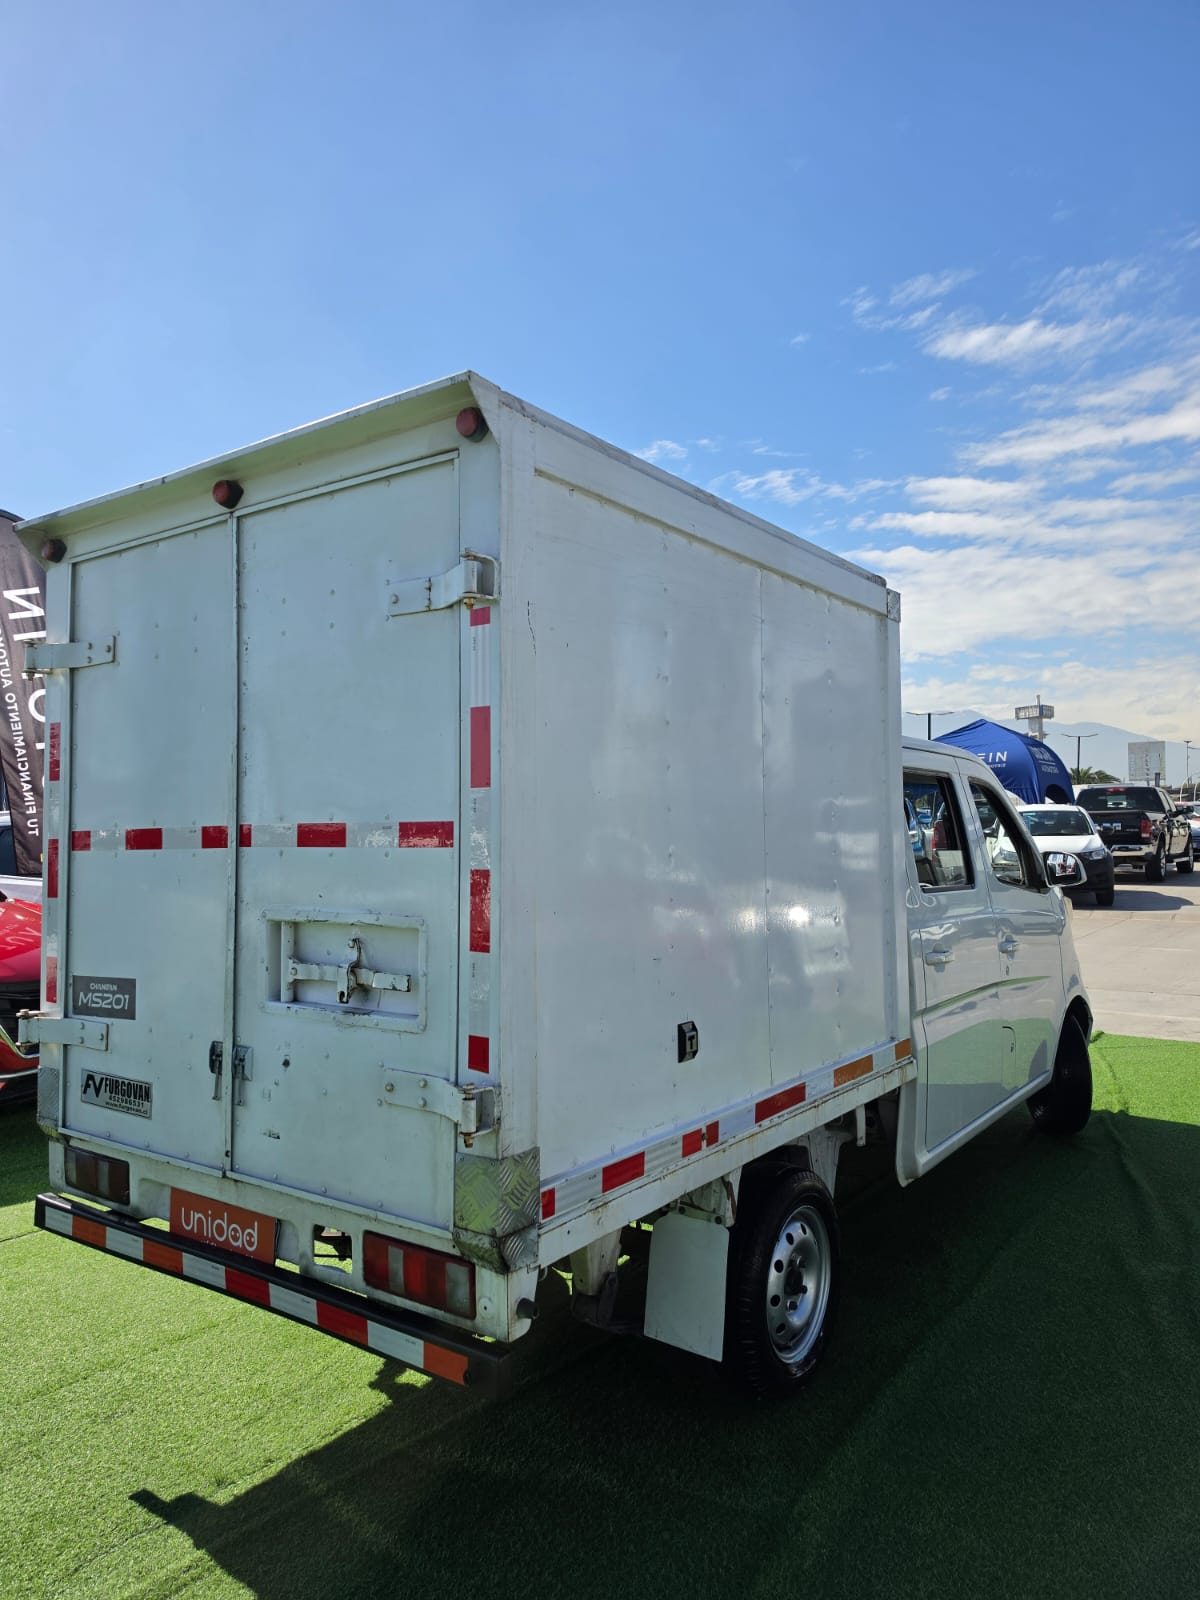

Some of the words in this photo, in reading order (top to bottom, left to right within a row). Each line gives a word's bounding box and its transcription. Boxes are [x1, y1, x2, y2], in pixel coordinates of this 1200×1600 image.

[79, 991, 129, 1010] MS201
[104, 1077, 150, 1103] FURGOVAN
[181, 1207, 258, 1252] unidad
